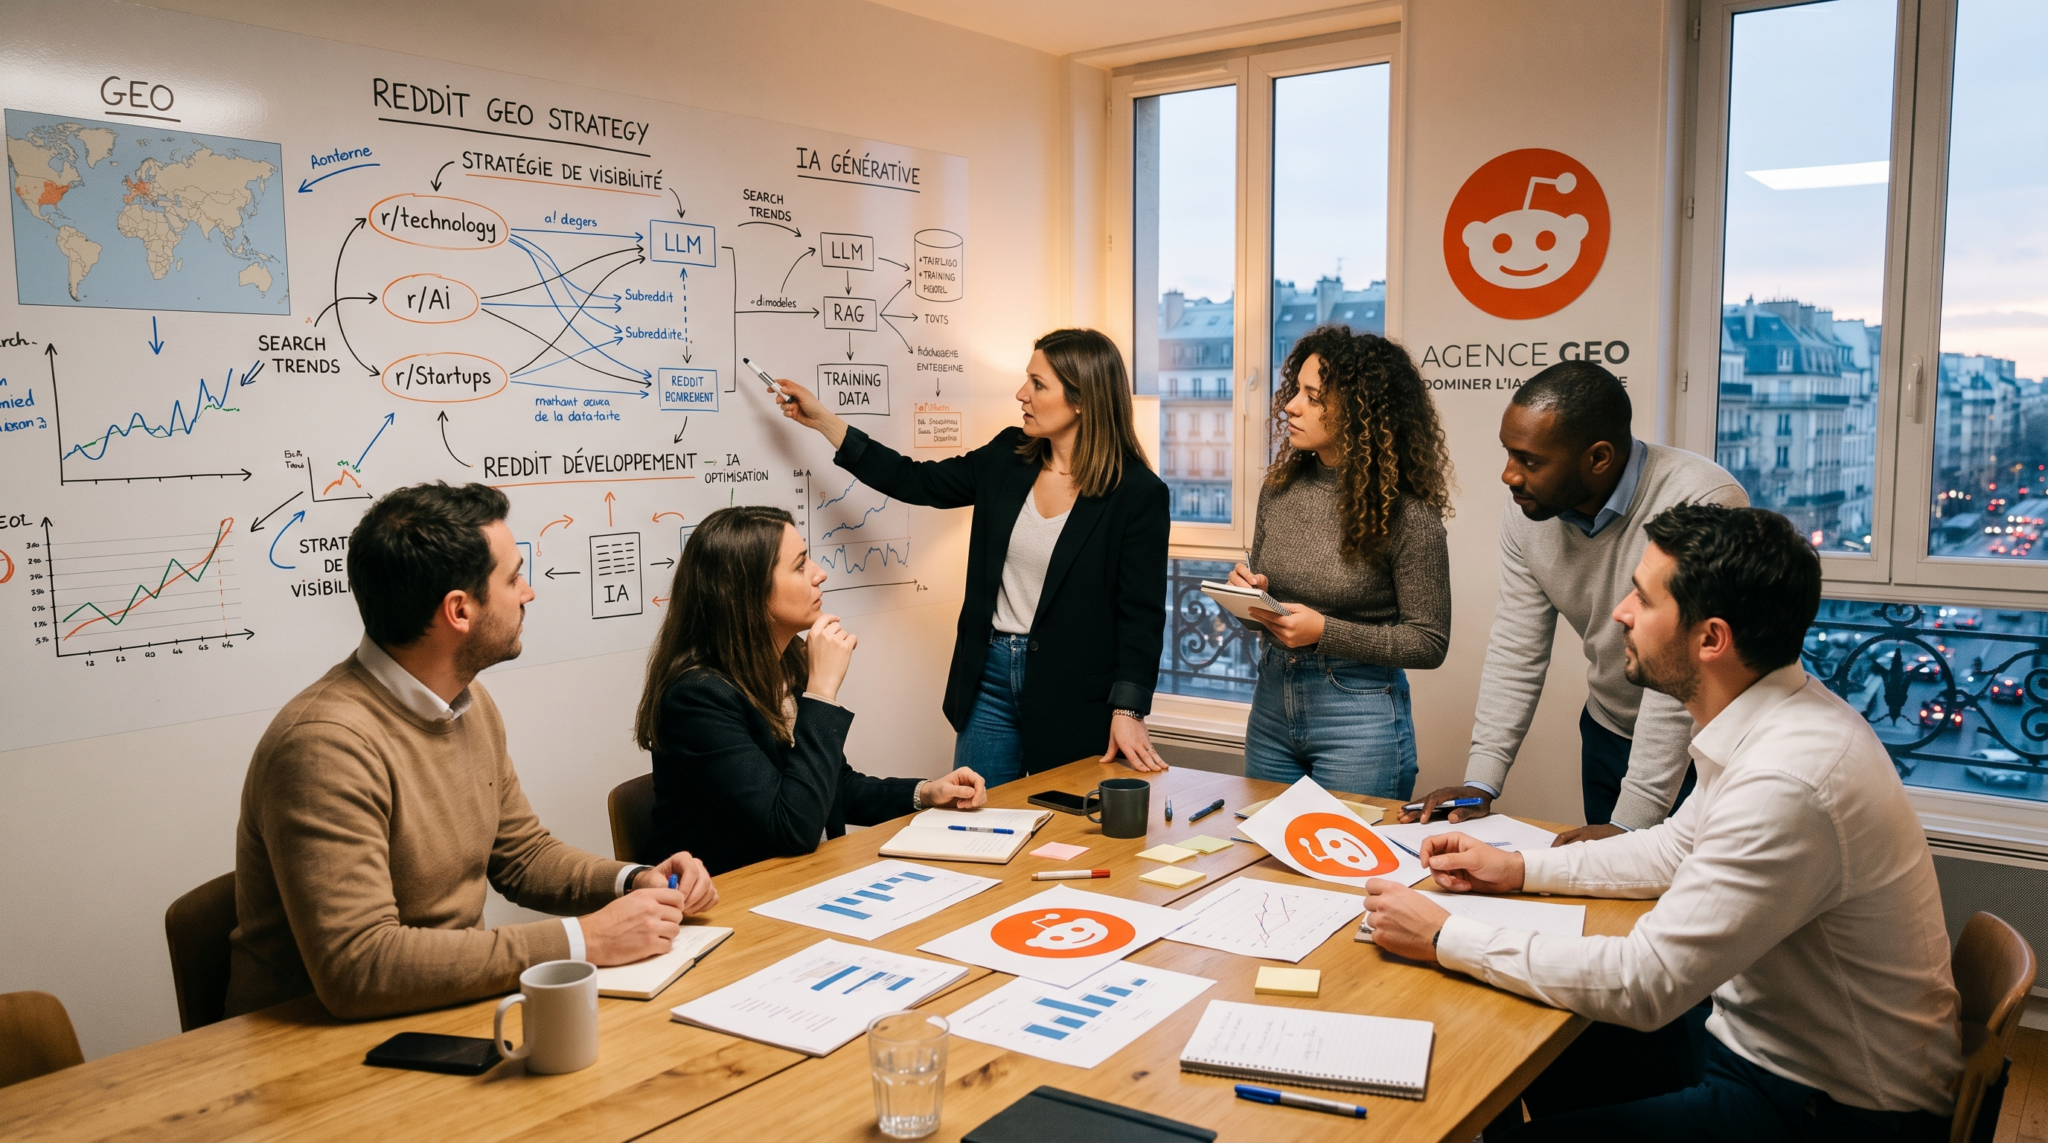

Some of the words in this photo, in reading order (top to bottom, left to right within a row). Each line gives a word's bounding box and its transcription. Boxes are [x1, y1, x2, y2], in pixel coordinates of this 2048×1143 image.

[99, 75, 175, 112] GEO
[486, 97, 534, 126] GEO
[548, 107, 650, 146] STRATEGY
[796, 146, 822, 171] IA
[561, 163, 583, 182] DE
[742, 188, 784, 205] SEARCH
[380, 204, 497, 243] r/technology
[560, 212, 598, 231] degers
[748, 206, 792, 222] TRENDS
[664, 232, 702, 255] LLM
[831, 240, 864, 262] LLM
[624, 288, 674, 304] Subreddit
[833, 302, 865, 323] RAG
[257, 335, 327, 352] SEARCH
[1421, 342, 1548, 368] AGENCE
[1559, 340, 1630, 366] GEO
[272, 358, 341, 374] TRENDS
[395, 363, 492, 393] r/Startups
[671, 375, 704, 388] REDDIT
[1423, 378, 1492, 390] DOMINER
[838, 391, 870, 406] DATA
[534, 412, 548, 423] de
[554, 411, 563, 422] la
[562, 447, 697, 475] DÉVELOPPEMENT
[726, 453, 741, 467] IA
[299, 536, 350, 554] STRAT
[324, 558, 343, 573] DE
[603, 584, 629, 603] IA
